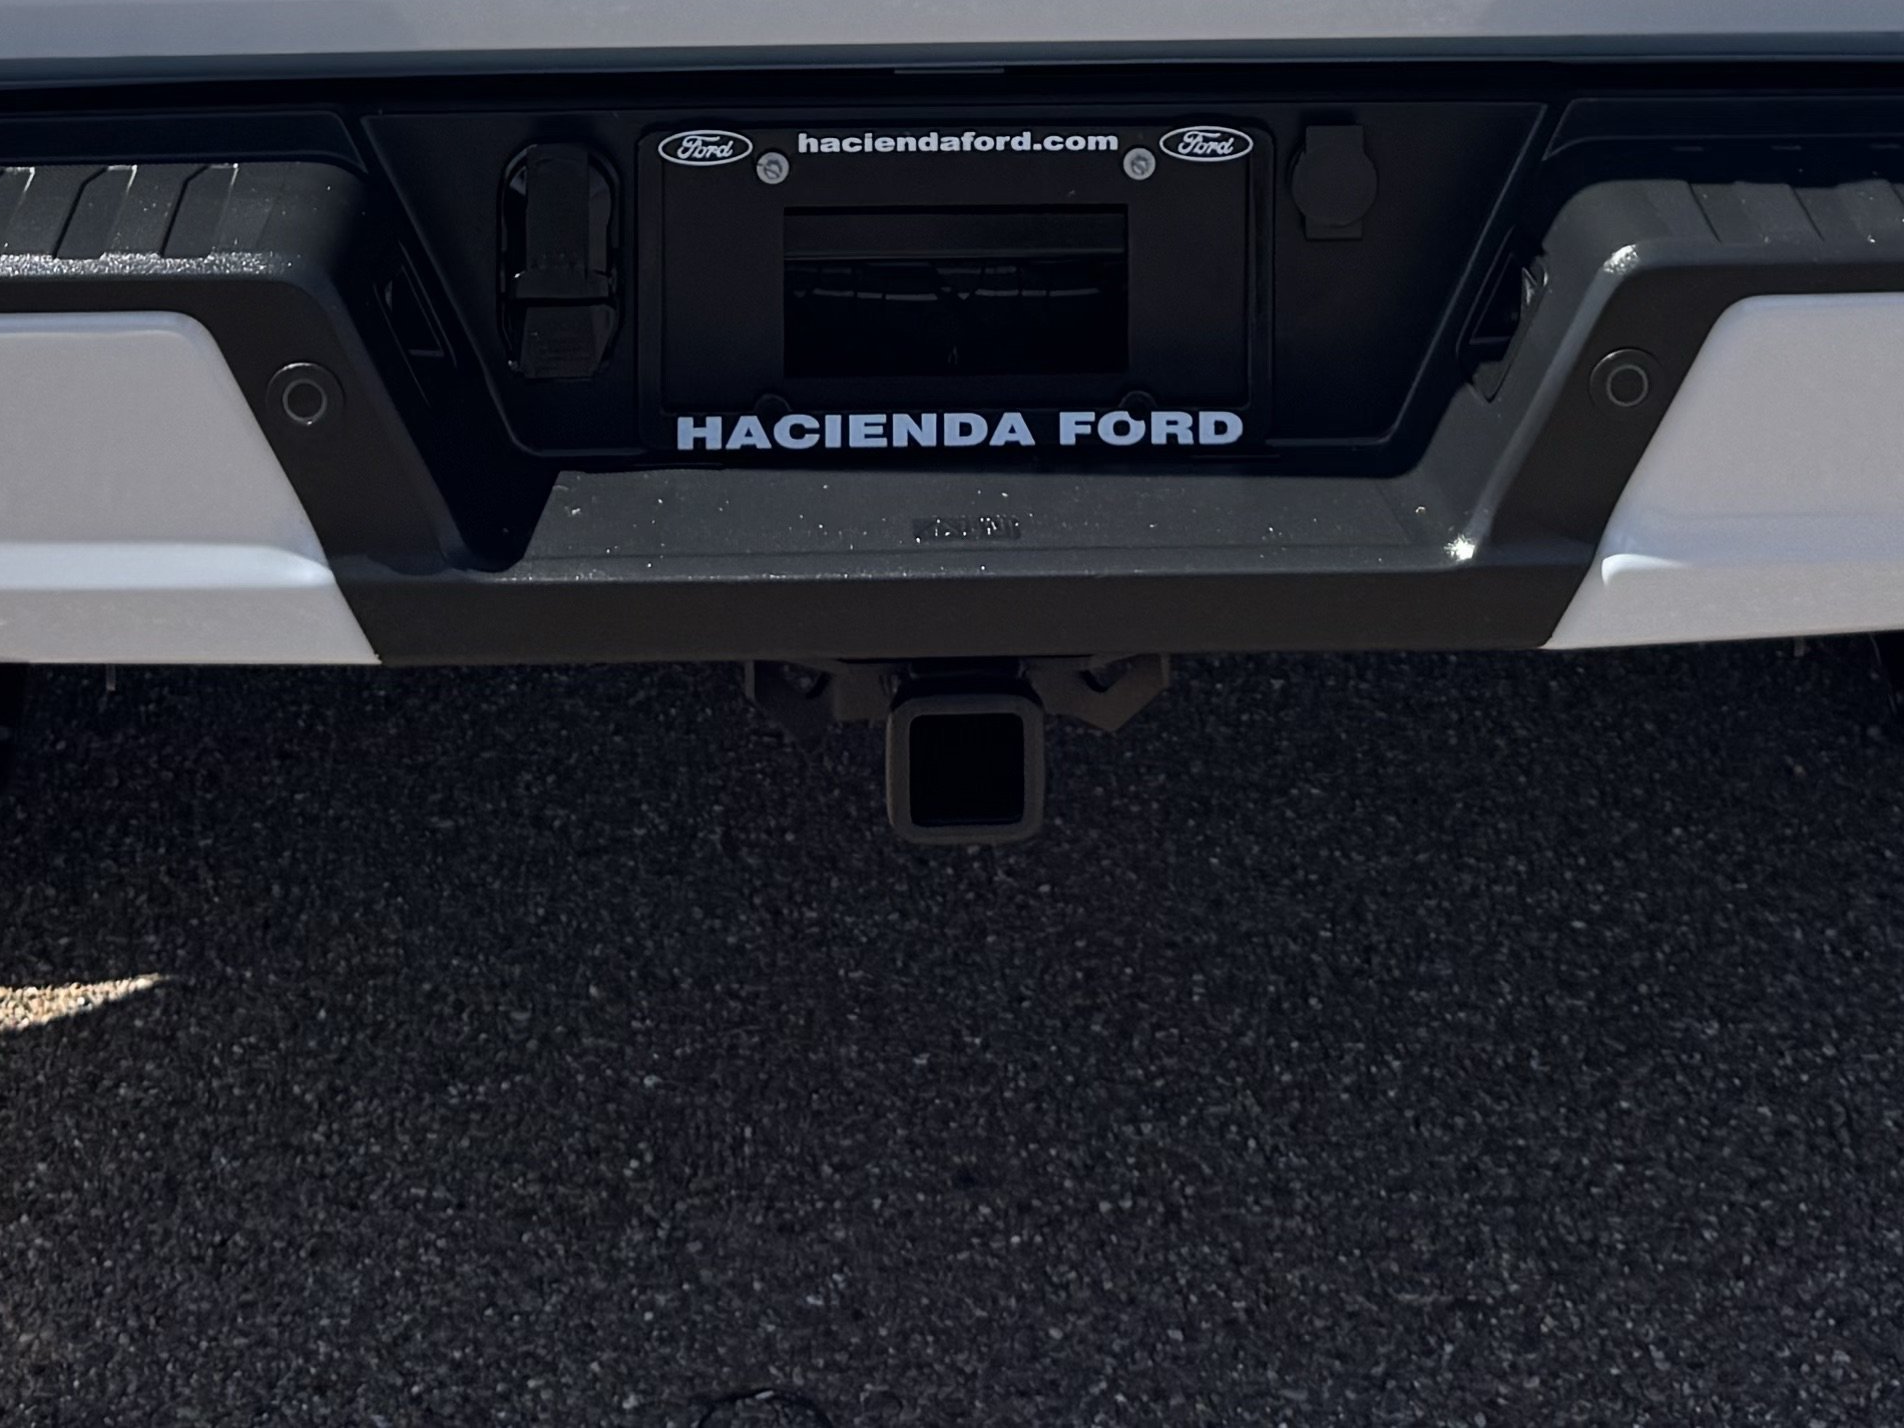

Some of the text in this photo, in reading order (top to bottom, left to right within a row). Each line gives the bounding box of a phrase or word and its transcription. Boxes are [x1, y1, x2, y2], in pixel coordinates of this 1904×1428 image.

[676, 135, 734, 160] Ford
[798, 131, 1118, 153] haciendaford.com
[1177, 130, 1235, 155] Ford
[676, 411, 1243, 450] HACIENDA FORD
